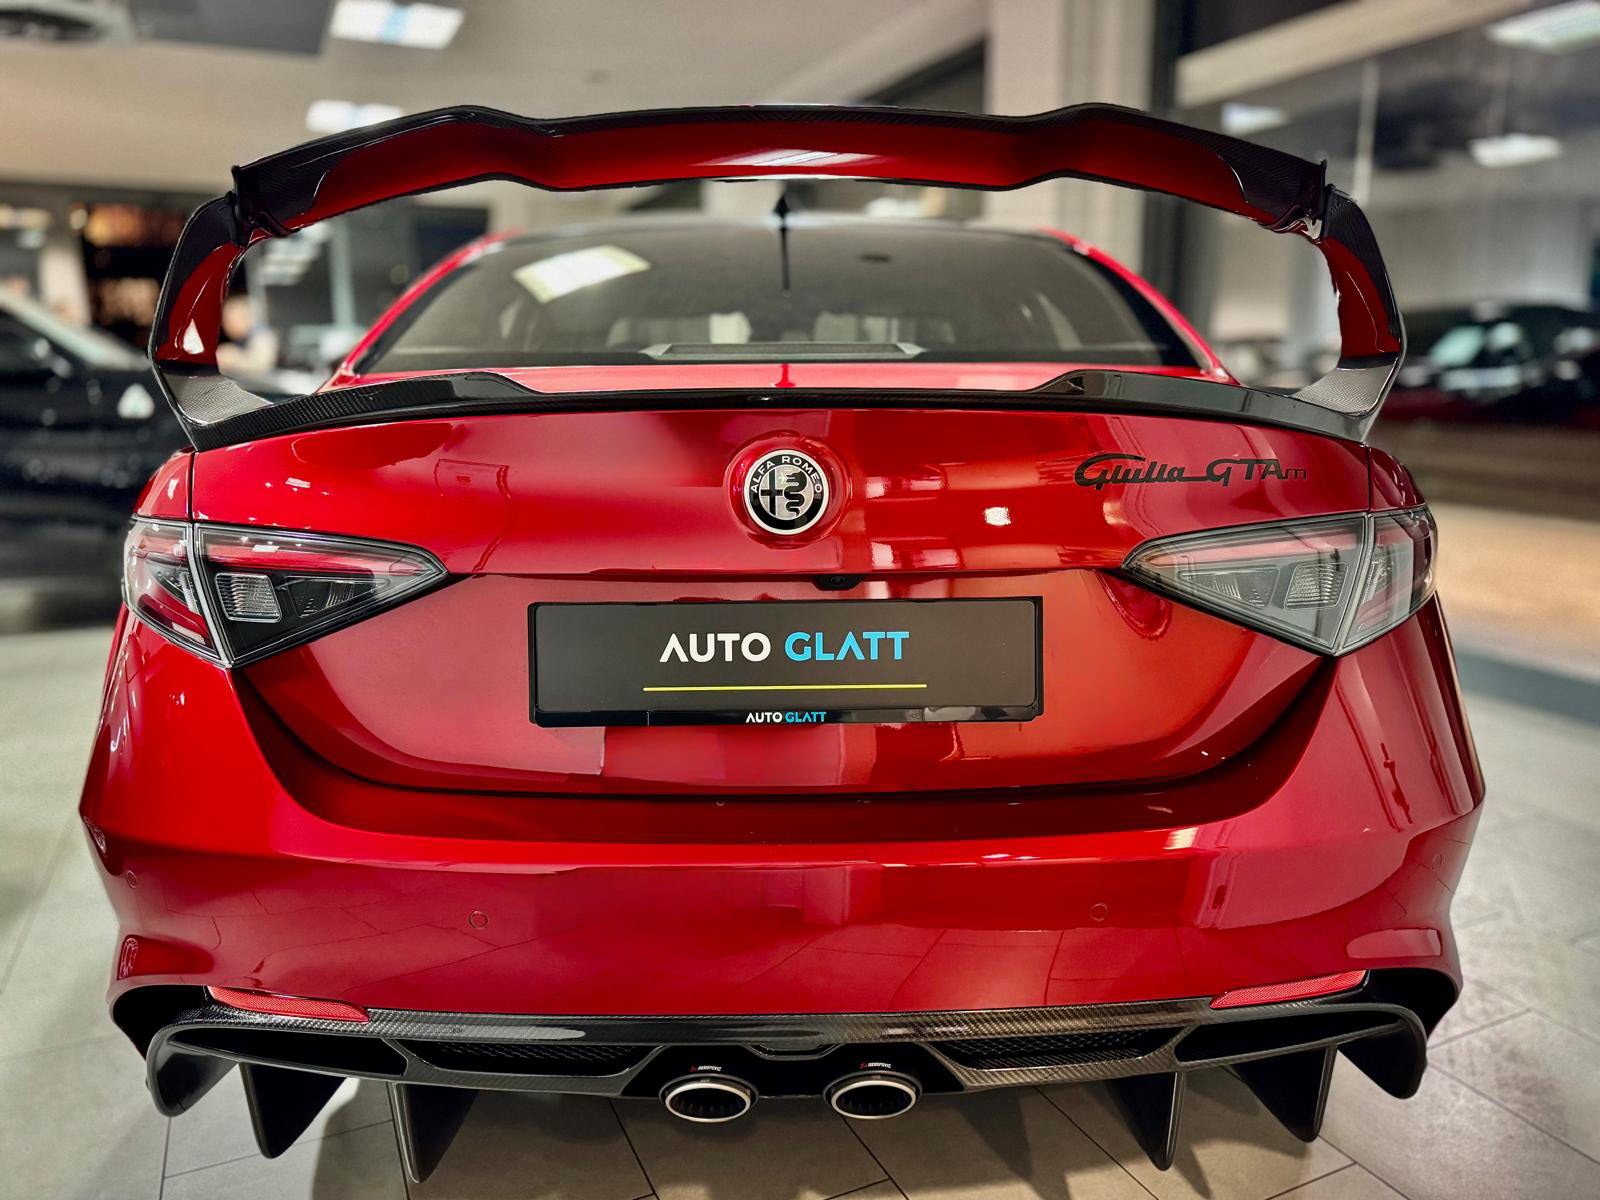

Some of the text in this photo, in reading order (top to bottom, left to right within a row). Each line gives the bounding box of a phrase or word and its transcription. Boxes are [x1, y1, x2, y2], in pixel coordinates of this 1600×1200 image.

[750, 455, 823, 494] ALFA ROMEO
[1074, 453, 1186, 490] Giulia
[659, 631, 910, 663] AUTO GLATT
[745, 711, 827, 723] AUTO GLATT
